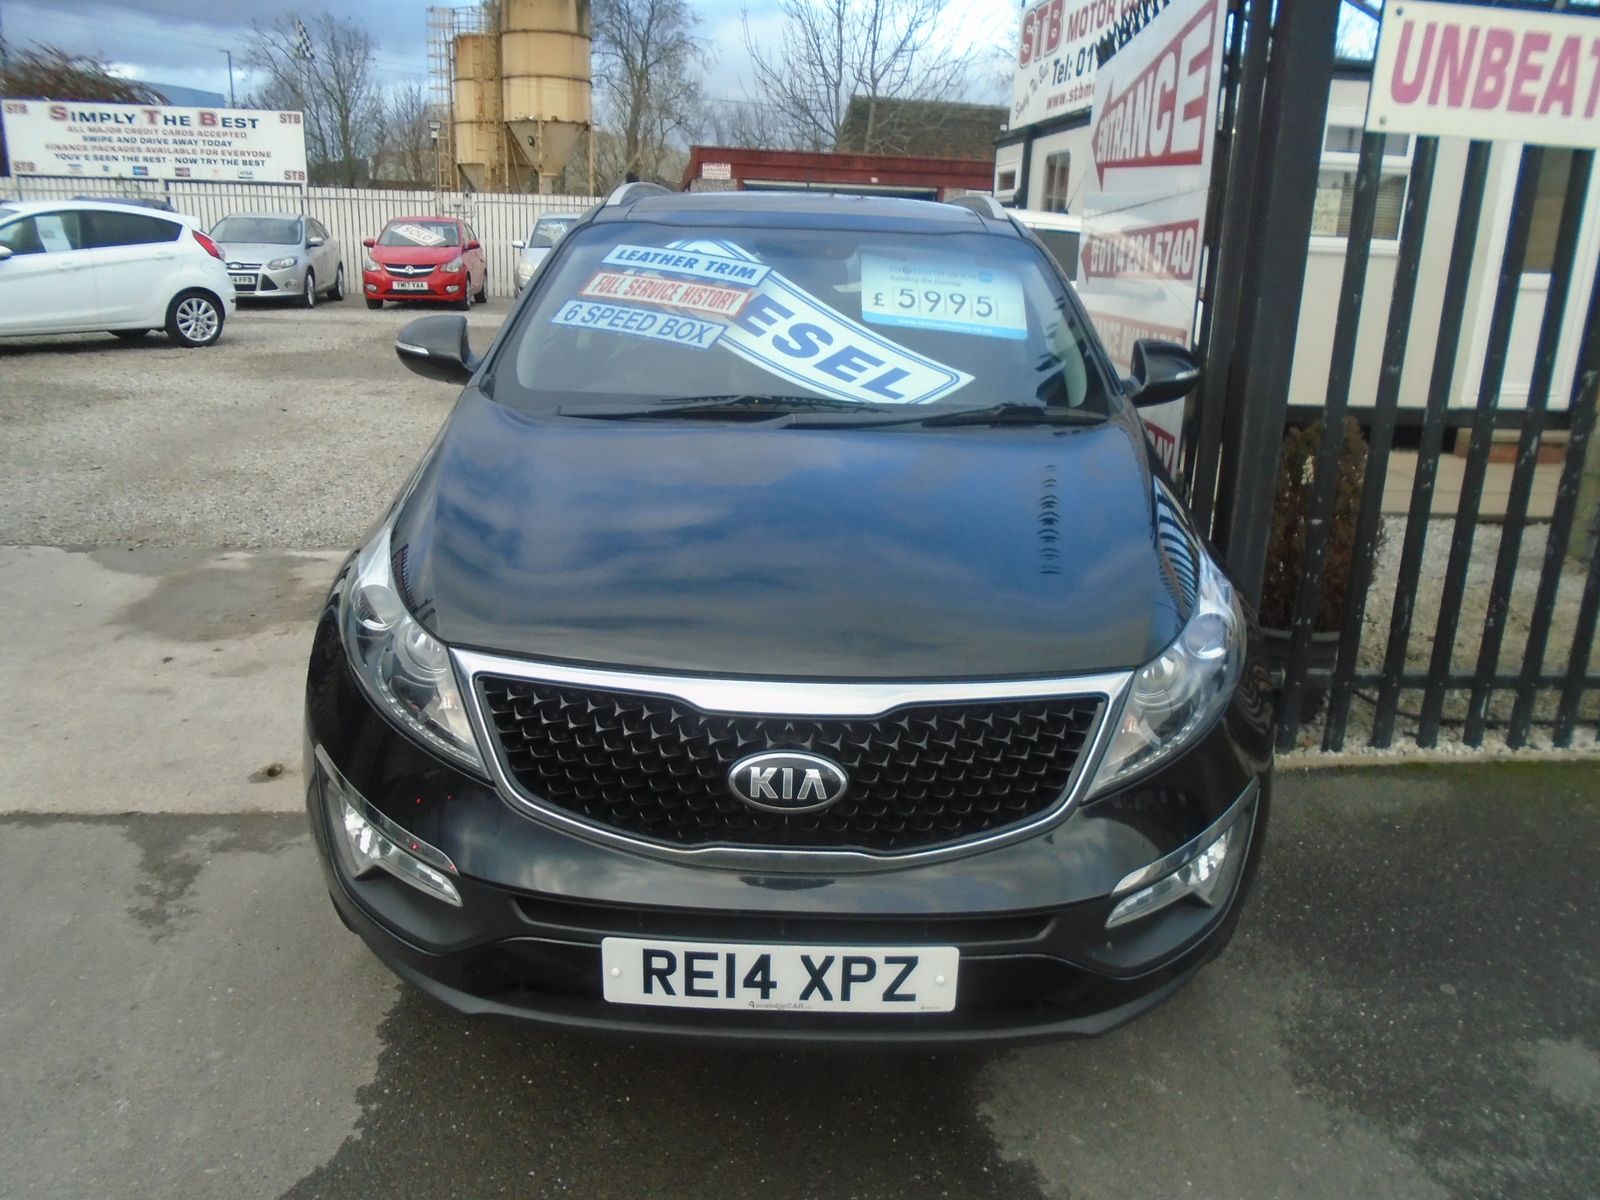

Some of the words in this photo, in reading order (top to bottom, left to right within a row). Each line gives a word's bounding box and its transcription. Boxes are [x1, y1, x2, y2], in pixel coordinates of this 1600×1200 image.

[1019, 0, 1064, 68] STB
[1067, 0, 1116, 43] MOTOR
[1052, 53, 1073, 86] Tel:
[1046, 82, 1095, 110] www.stbm
[1097, 11, 1213, 163] ENTRANCE
[50, 106, 135, 124] SIMPLY
[142, 109, 191, 126] THE
[200, 112, 259, 129] BEST
[279, 113, 301, 125] STB
[197, 130, 248, 139] ACCEPTED
[201, 139, 233, 147] TODAY
[200, 148, 219, 156] FOR
[221, 150, 272, 158] EVERYONE
[201, 158, 217, 166] TRY
[221, 158, 239, 166] THE
[242, 159, 265, 167] BEST
[284, 170, 306, 181] STB
[614, 249, 700, 269] LEATHER
[704, 260, 757, 281] TRIM
[591, 274, 620, 290] FULL
[623, 278, 679, 303] SERVICE
[678, 284, 743, 311] HISTORY
[898, 288, 993, 318] 5995
[563, 304, 584, 322] 6
[581, 305, 659, 331] SPEED
[657, 318, 716, 344] BOX
[732, 293, 913, 400] ESEL
[750, 766, 827, 800] KIA
[643, 948, 777, 1000] RE14
[799, 954, 919, 1002] XPZ
